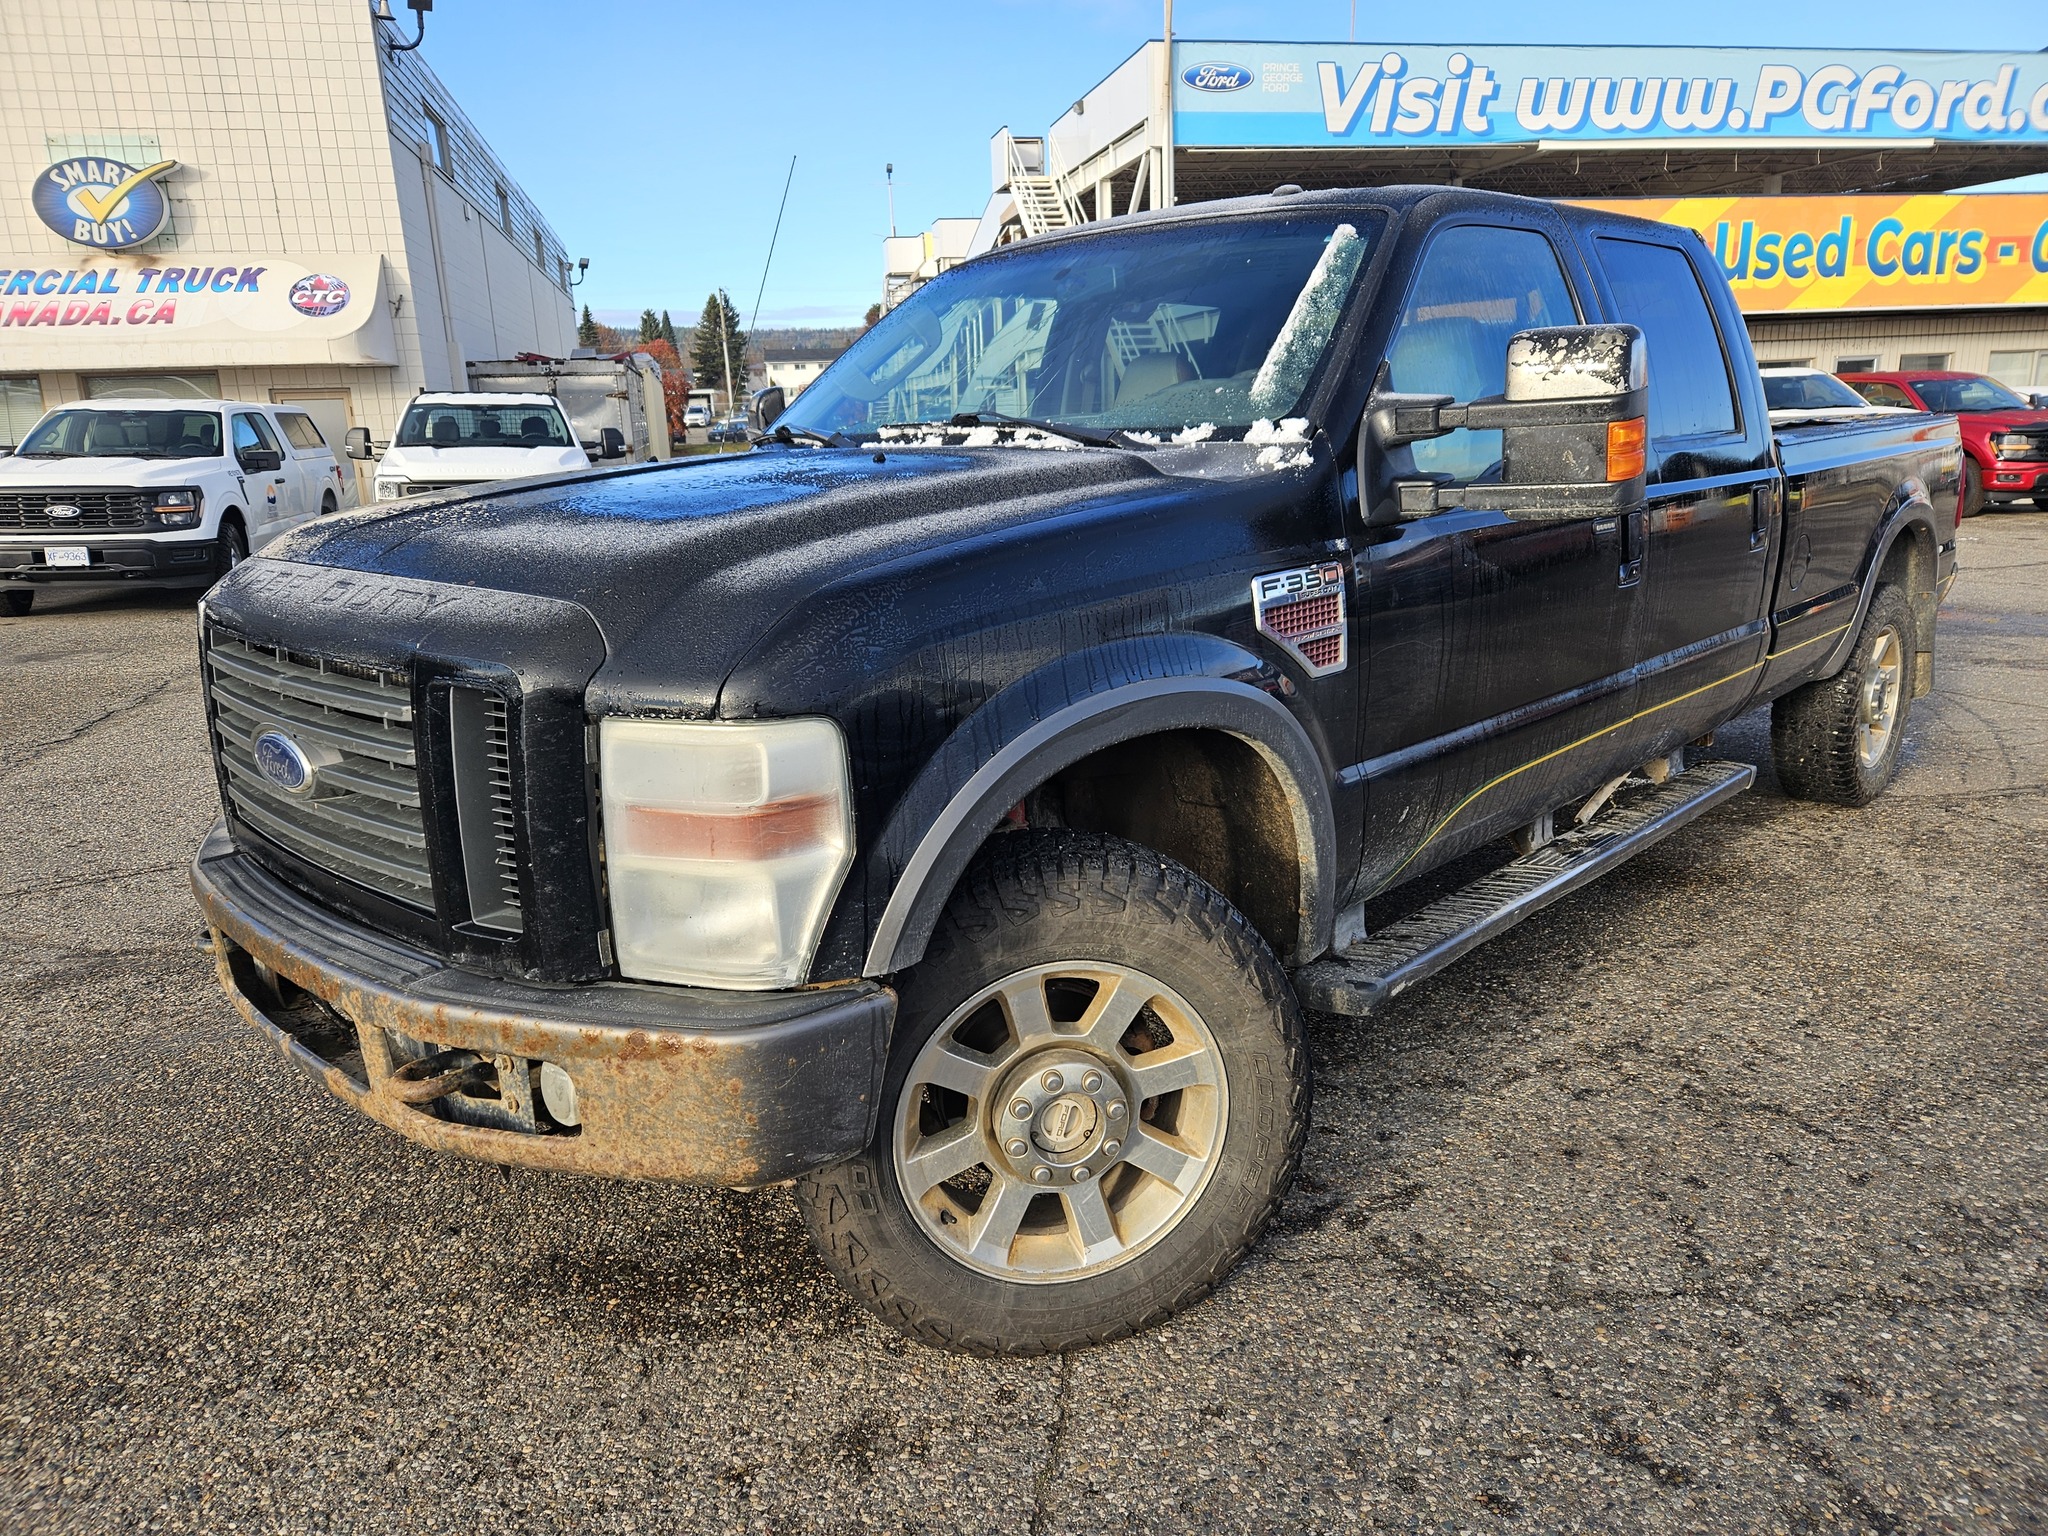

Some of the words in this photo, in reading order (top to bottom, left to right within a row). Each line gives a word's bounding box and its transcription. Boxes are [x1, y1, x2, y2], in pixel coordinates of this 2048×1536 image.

[1195, 65, 1240, 88] Ford
[1262, 63, 1300, 73] PRINCE
[1262, 73, 1304, 83] GEORGE
[1262, 83, 1290, 93] FORD
[1317, 52, 1498, 135] Visit
[49, 160, 137, 193] SMART
[73, 218, 138, 245] BUY!
[1714, 215, 1854, 282] Used
[1866, 217, 1985, 279] Cars
[136, 267, 268, 294] TRUCK
[290, 290, 346, 304] CTC
[0, 299, 177, 327] NADA.CA
[261, 743, 292, 782] Ford
[1056, 1104, 1070, 1137] FORD
[1231, 1053, 1275, 1214] COOPER
